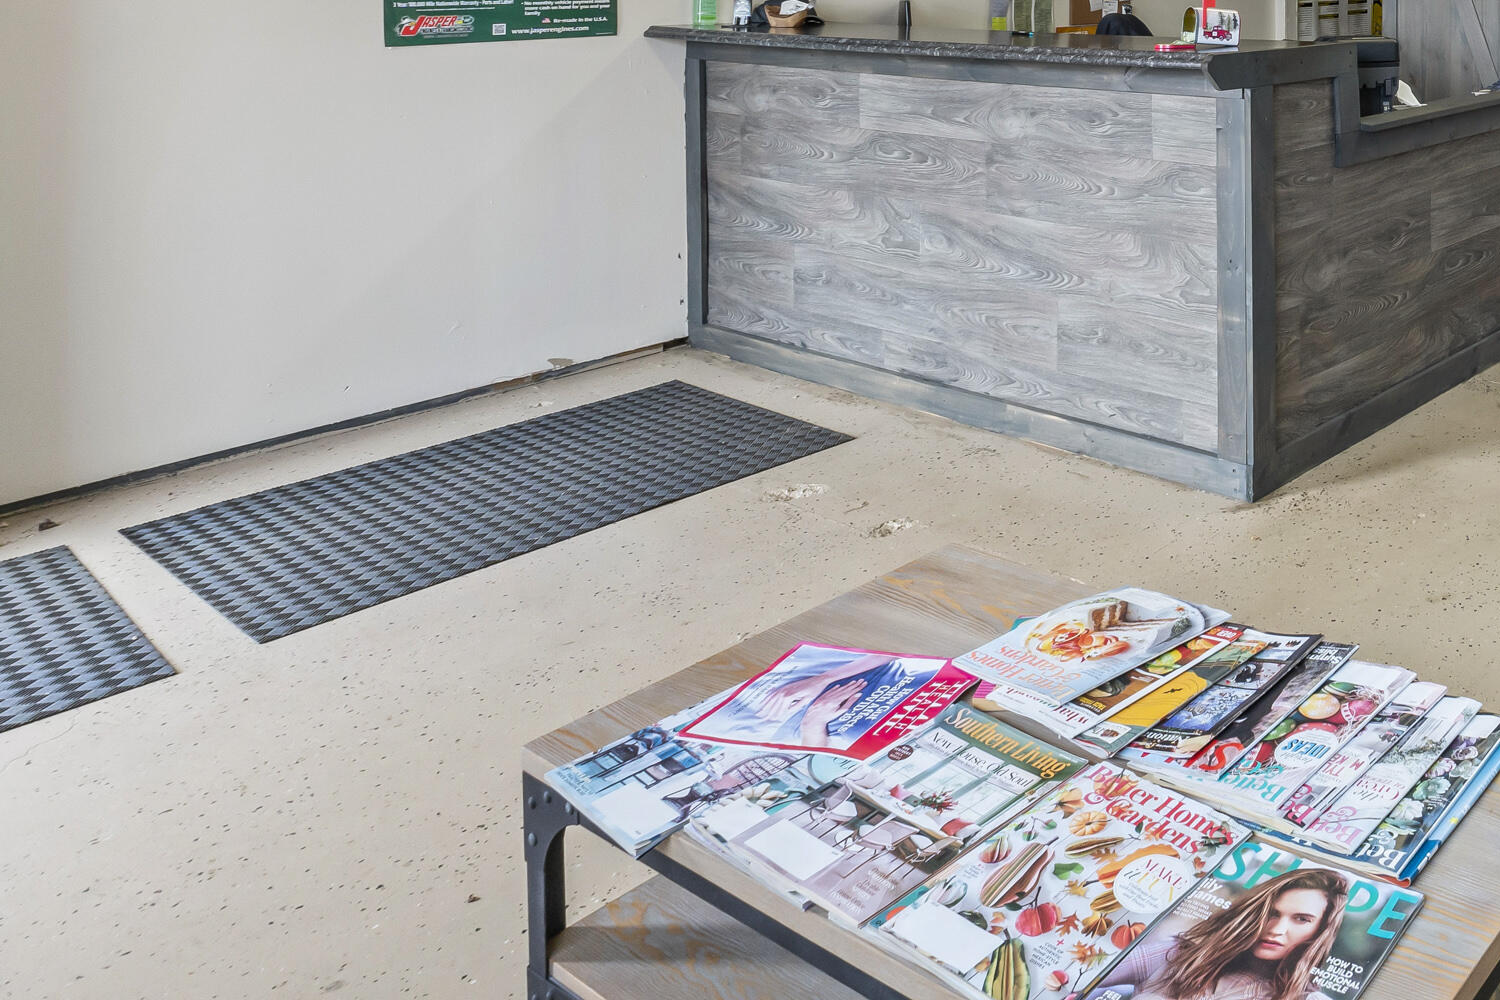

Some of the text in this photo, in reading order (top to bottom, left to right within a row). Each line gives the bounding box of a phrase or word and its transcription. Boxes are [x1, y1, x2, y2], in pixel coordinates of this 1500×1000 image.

[401, 16, 458, 36] JASPER
[512, 26, 589, 34] www.jasperengines.com
[969, 651, 1024, 678] Homes
[999, 646, 1064, 680] Gardens
[874, 675, 916, 702] Health
[1017, 673, 1076, 700] Better
[836, 684, 892, 722] COVID-19
[863, 687, 914, 721] How Gut
[896, 684, 948, 730] HEALTH
[944, 708, 1019, 754] Southern
[1010, 740, 1071, 779] Living
[1281, 740, 1331, 759] IDEAS
[931, 728, 1033, 788] New House Old Soul
[1087, 764, 1239, 845] Better Homes
[1106, 798, 1201, 854] Gardens
[1326, 956, 1364, 973] HOW TO
[1327, 965, 1353, 978] BUILD
[1310, 967, 1360, 990] EMOTIONAL
[1312, 976, 1349, 994] MUSCLE
